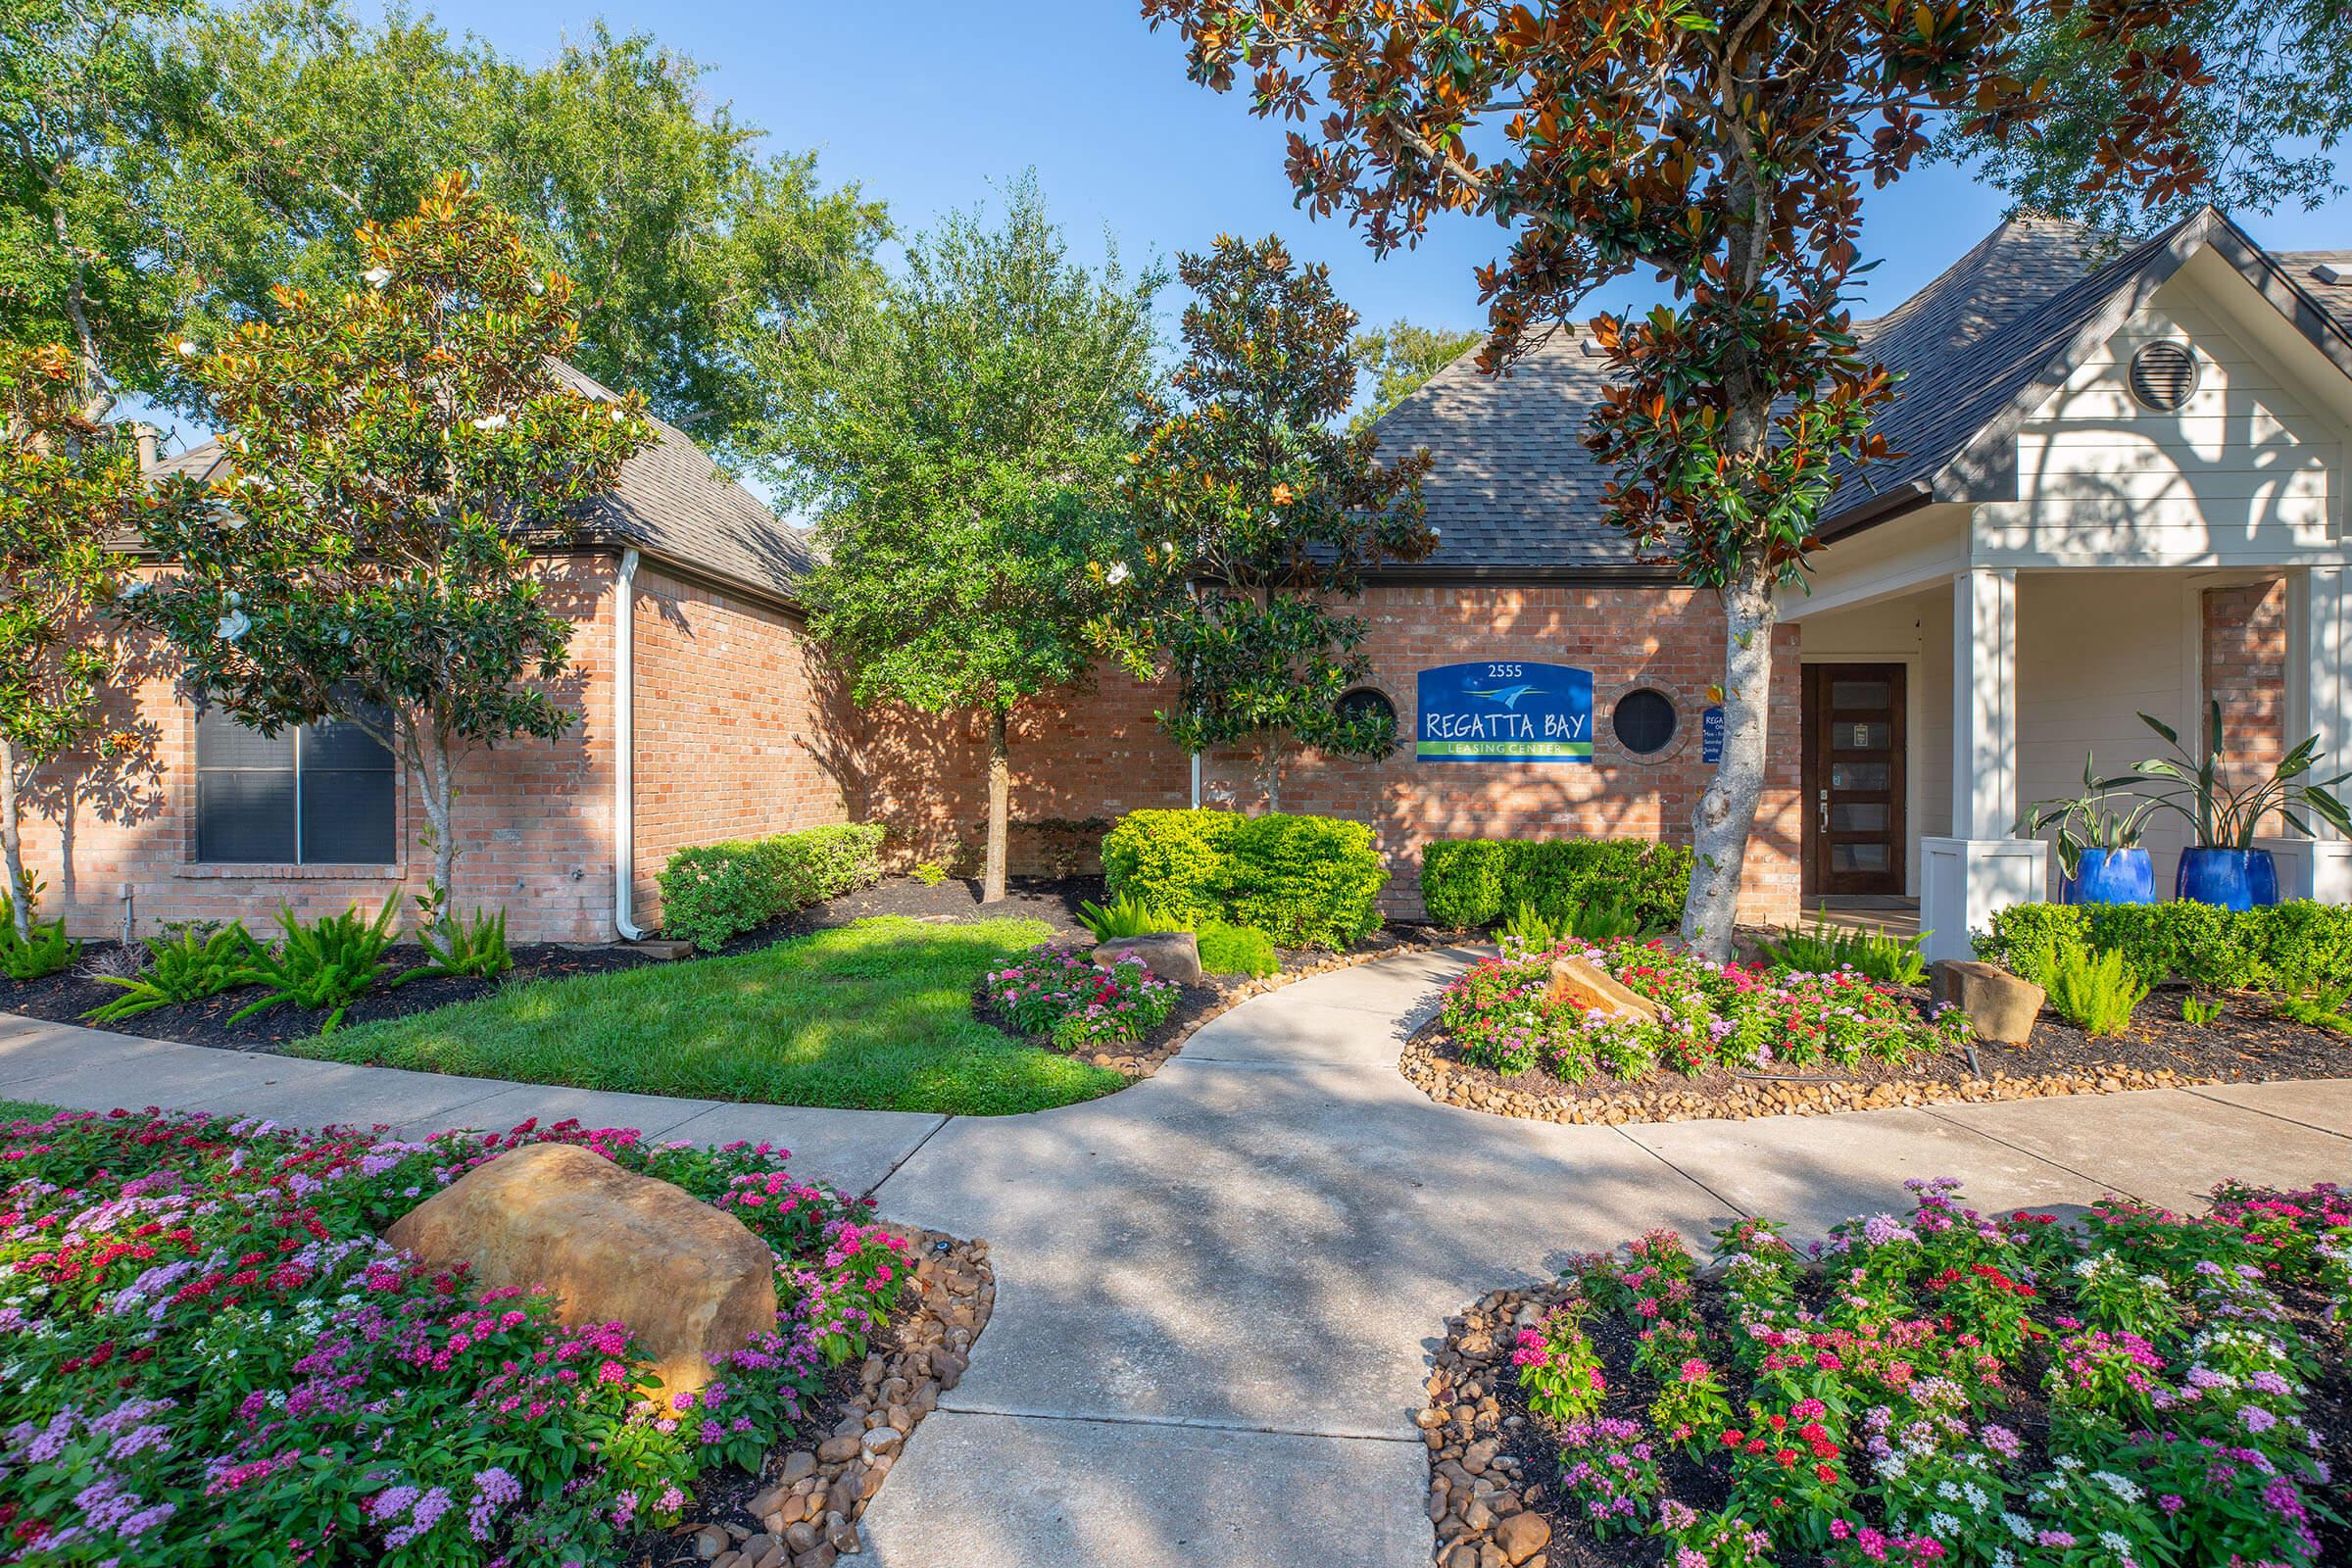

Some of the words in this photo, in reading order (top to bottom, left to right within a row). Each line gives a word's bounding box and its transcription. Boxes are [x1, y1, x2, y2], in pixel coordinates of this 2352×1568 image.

[1488, 664, 1522, 677] 2555
[1426, 712, 1535, 739] REGATTA
[1544, 713, 1586, 738] BAY
[1447, 744, 1505, 754] LEASING
[1508, 744, 1562, 754] CENTER
